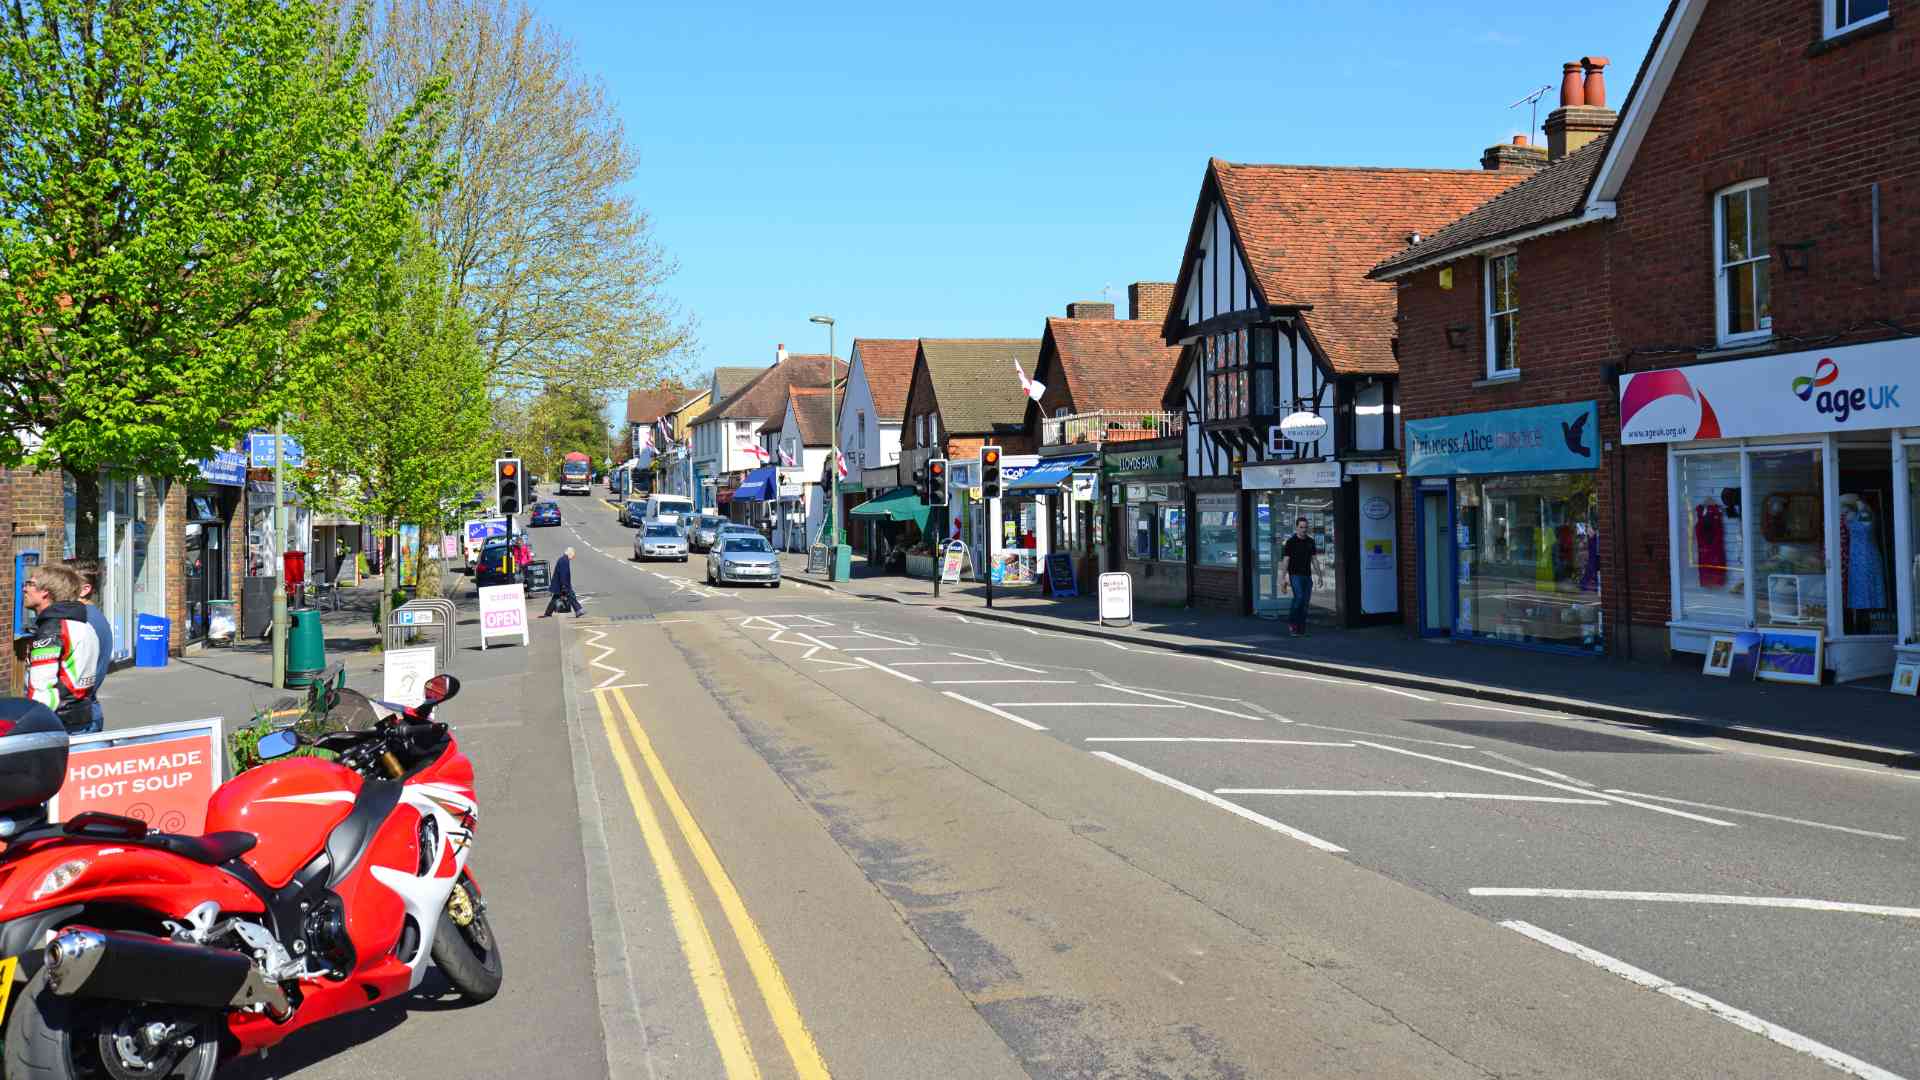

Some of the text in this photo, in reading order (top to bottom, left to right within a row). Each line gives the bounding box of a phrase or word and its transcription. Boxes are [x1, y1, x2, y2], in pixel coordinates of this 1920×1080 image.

[1816, 384, 1900, 422] age UK
[1412, 433, 1459, 457] Princess
[1462, 429, 1494, 453] Alice
[1119, 456, 1159, 472] LLOYDS BANK
[486, 610, 520, 627] OPEN
[70, 750, 202, 782] HOMEMADE
[80, 772, 193, 800] HOT SOUP
